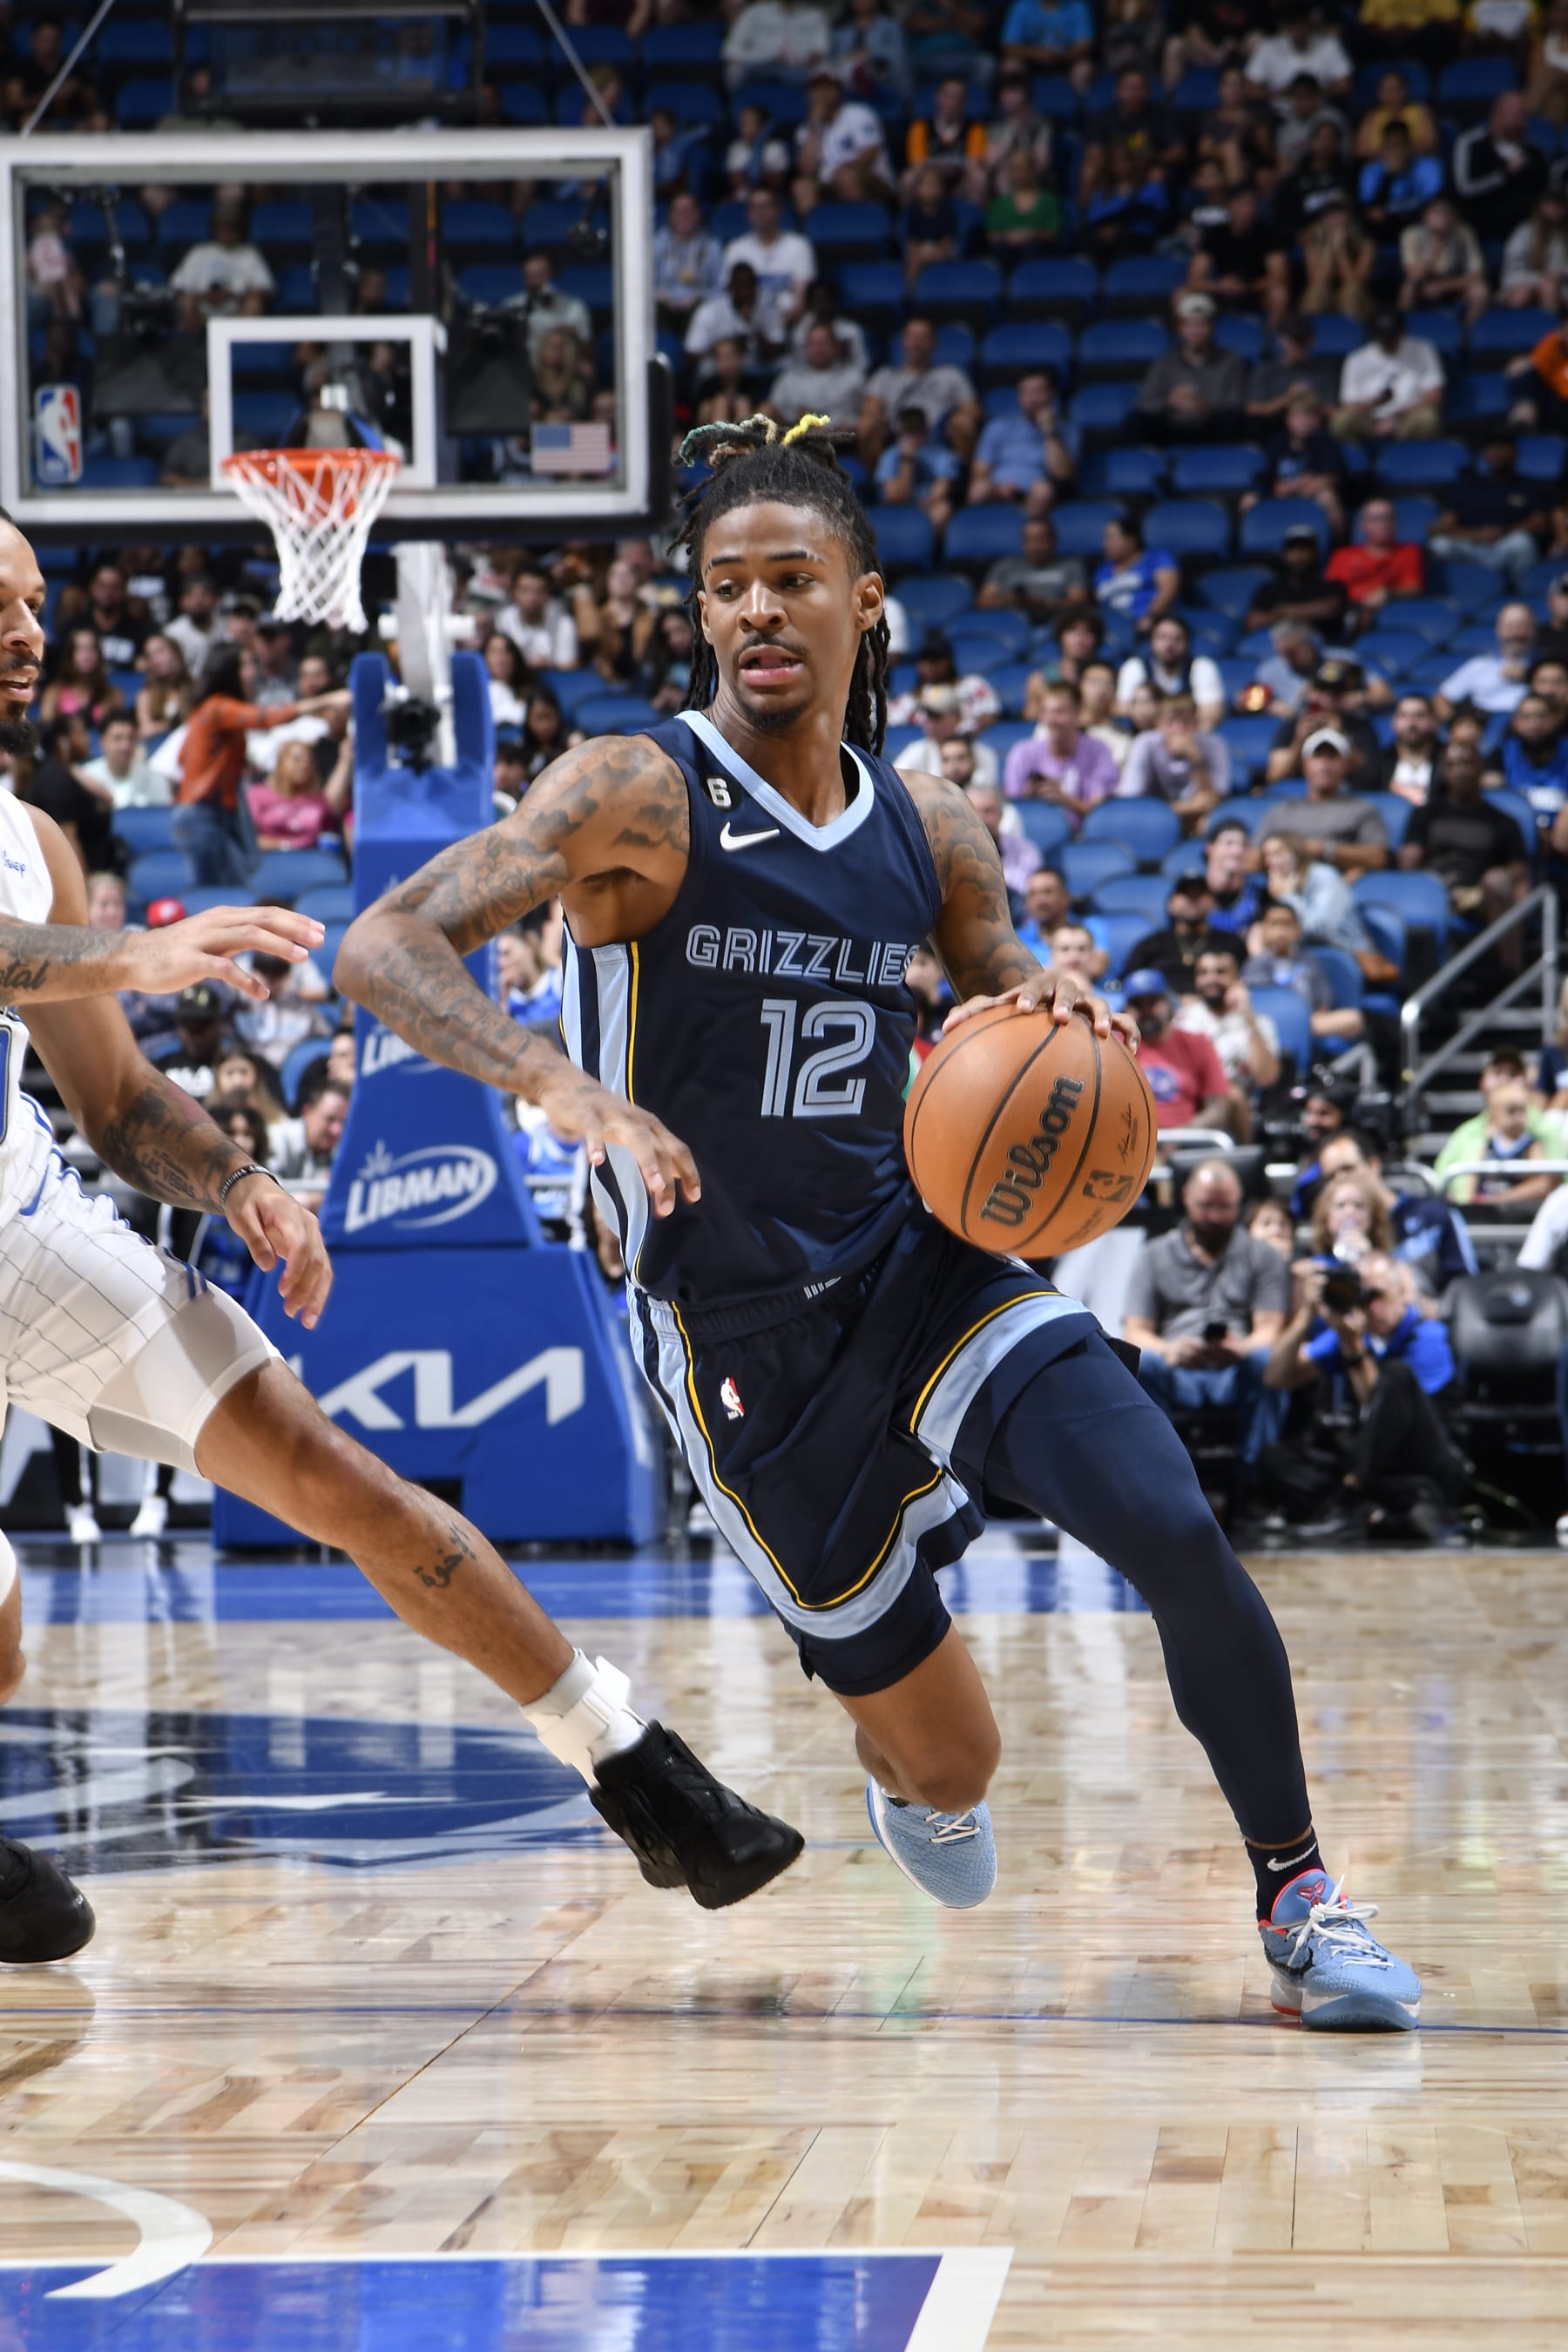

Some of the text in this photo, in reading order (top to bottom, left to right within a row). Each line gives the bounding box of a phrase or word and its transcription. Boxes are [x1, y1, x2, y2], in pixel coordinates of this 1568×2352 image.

[706, 778, 732, 808] 6
[760, 998, 876, 1118] 12
[344, 1160, 481, 1234] LIBMAN
[978, 1075, 1085, 1227] Wilson
